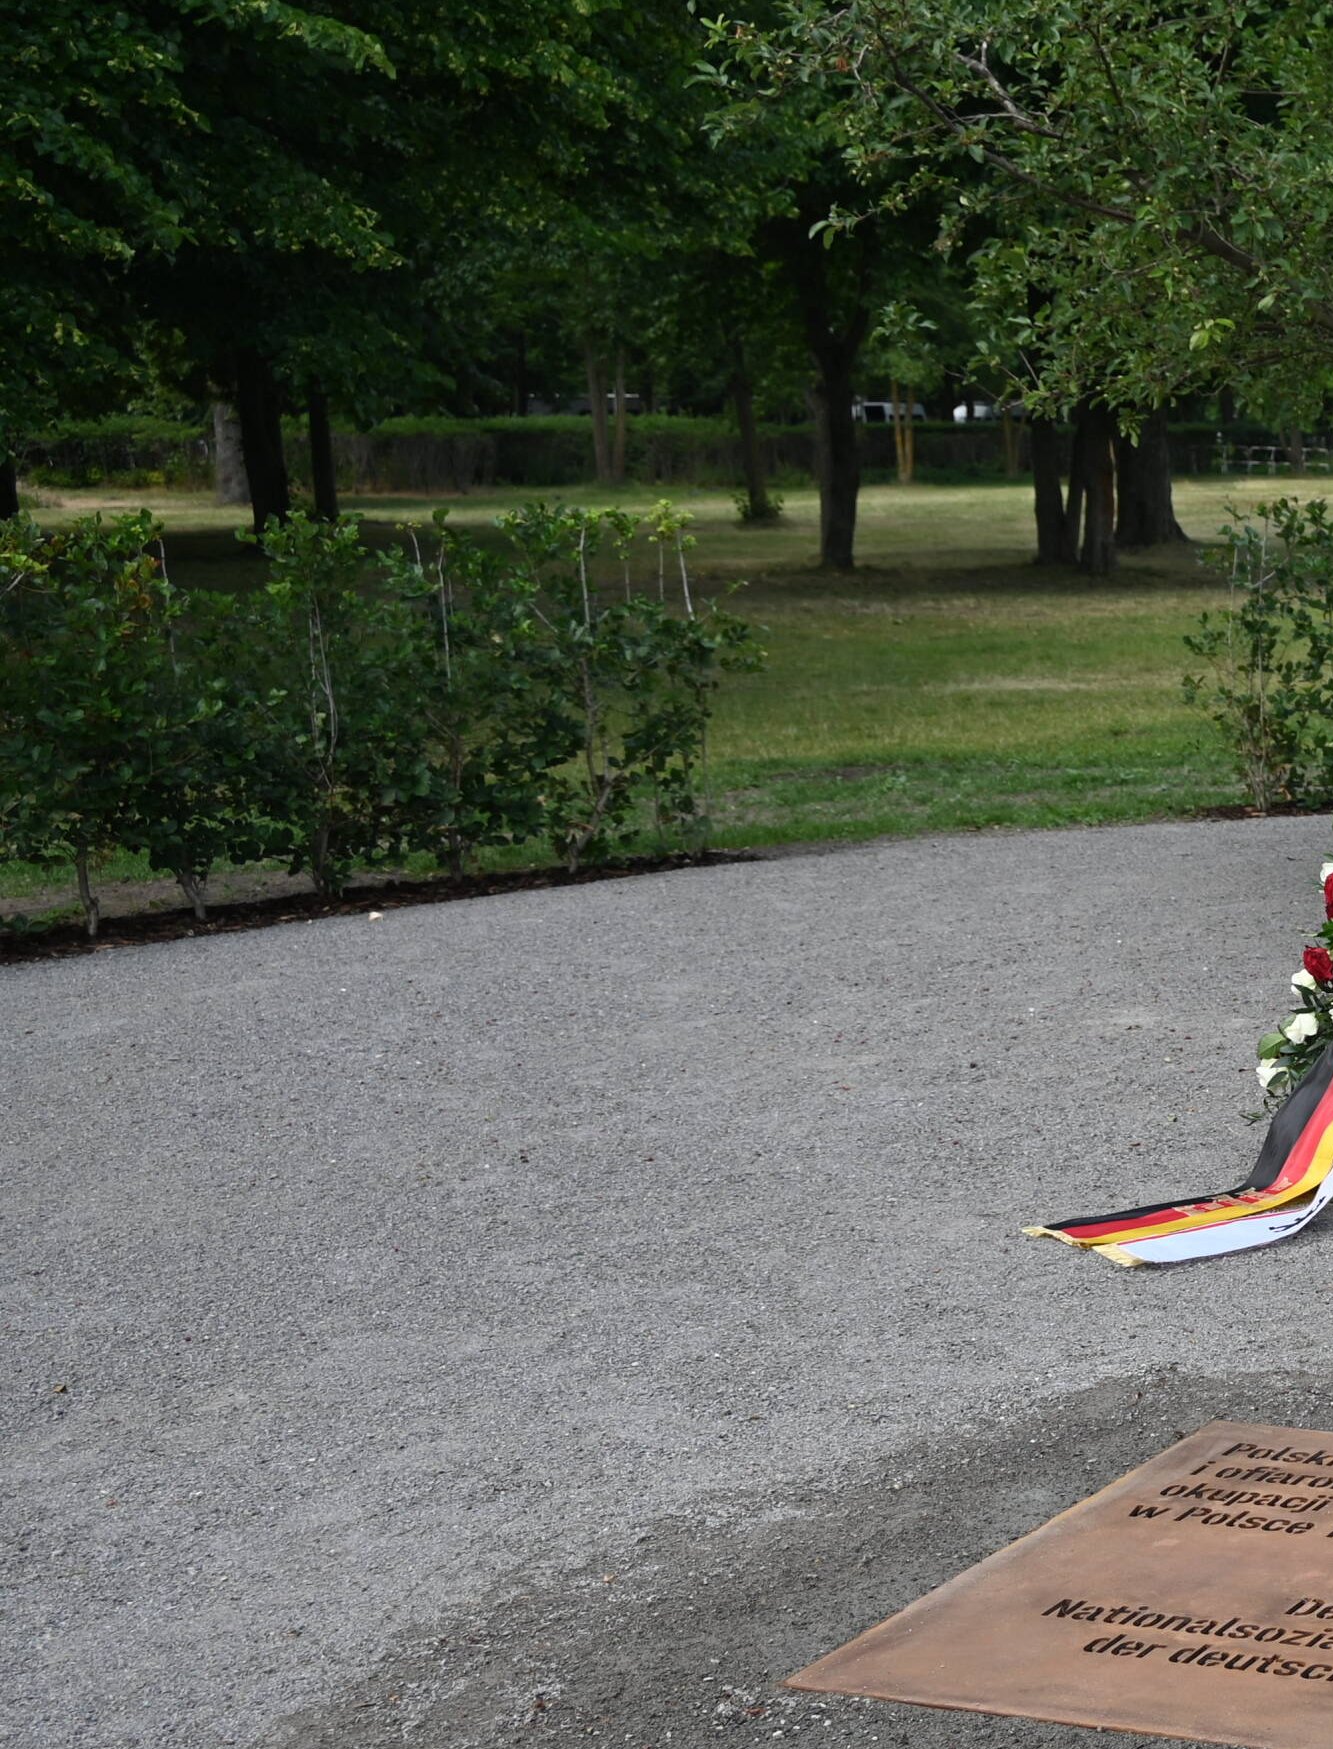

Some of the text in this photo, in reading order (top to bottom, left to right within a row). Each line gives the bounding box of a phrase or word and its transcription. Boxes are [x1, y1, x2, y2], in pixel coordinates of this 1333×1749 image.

[1190, 1460, 1217, 1476] i
[1128, 1504, 1171, 1519] w
[1173, 1505, 1315, 1534] Polsce
[1083, 1633, 1168, 1658] der
